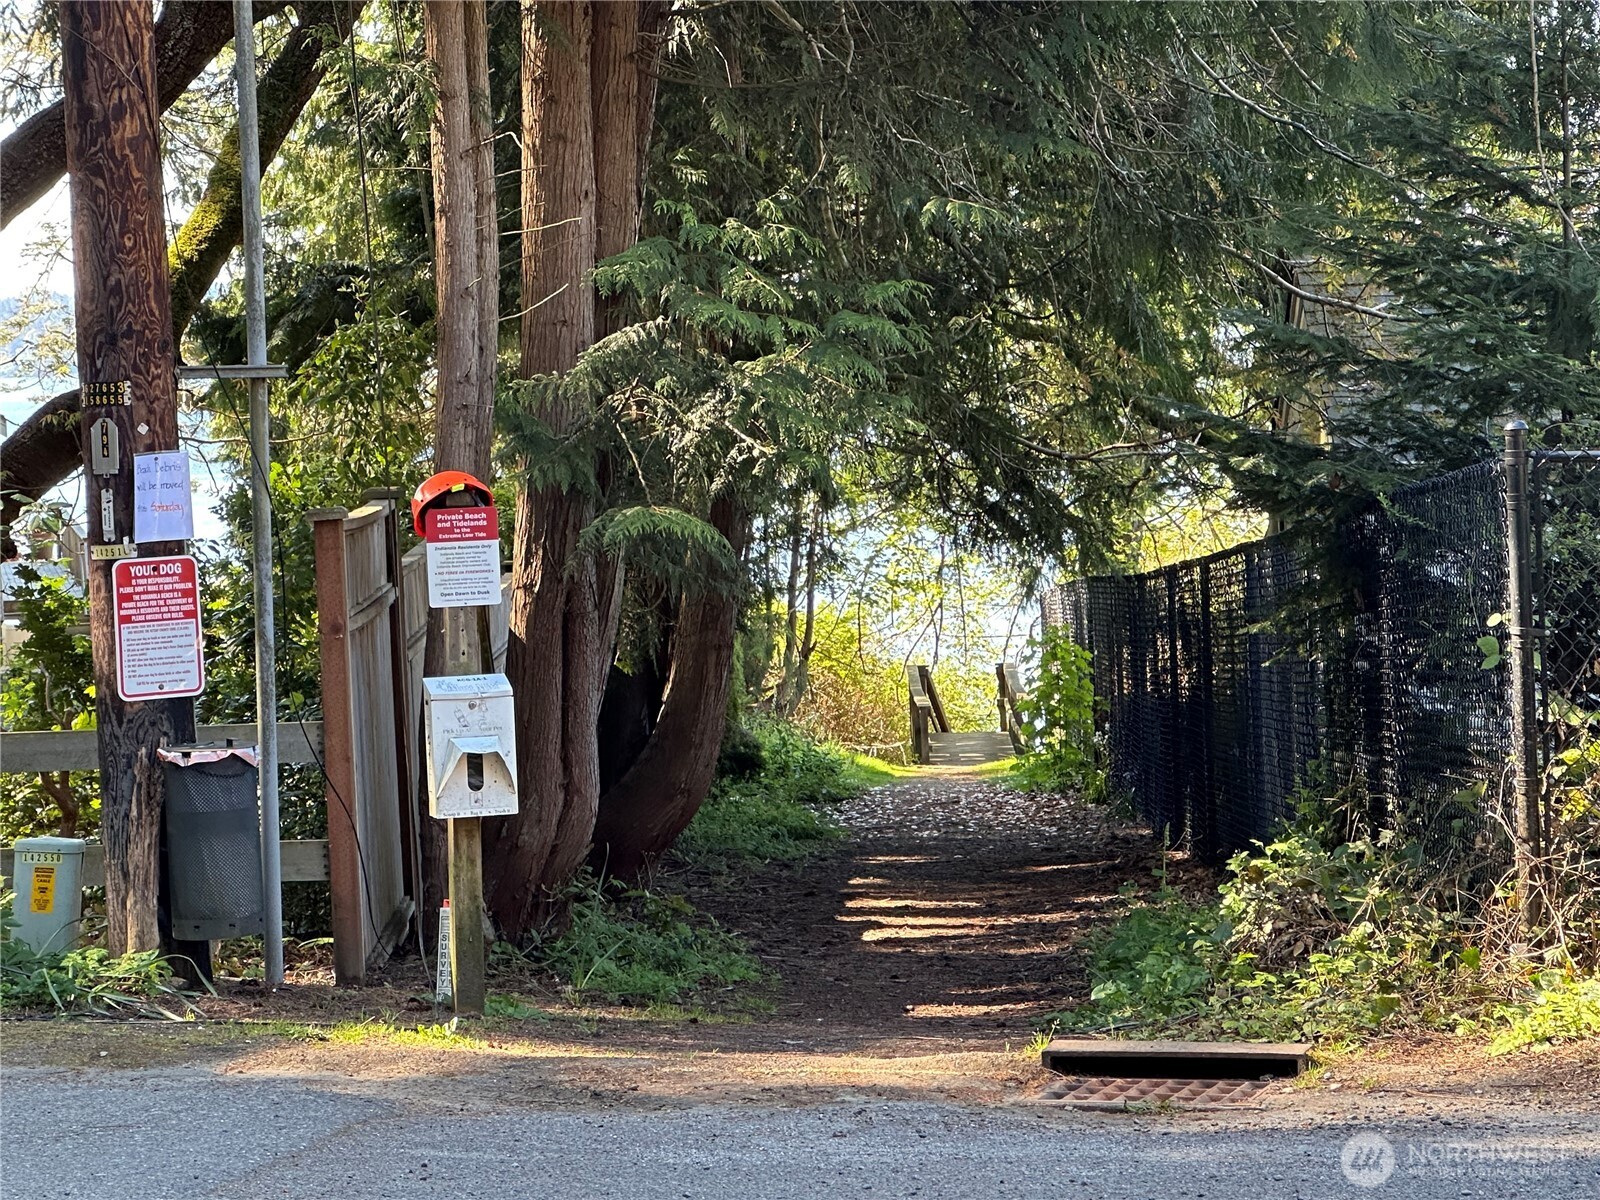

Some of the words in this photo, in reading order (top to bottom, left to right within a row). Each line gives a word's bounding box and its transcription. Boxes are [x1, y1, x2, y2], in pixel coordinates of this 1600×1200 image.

[149, 480, 156, 490] be
[160, 480, 183, 490] moved
[160, 563, 182, 575] DOG
[24, 854, 60, 862] 142550
